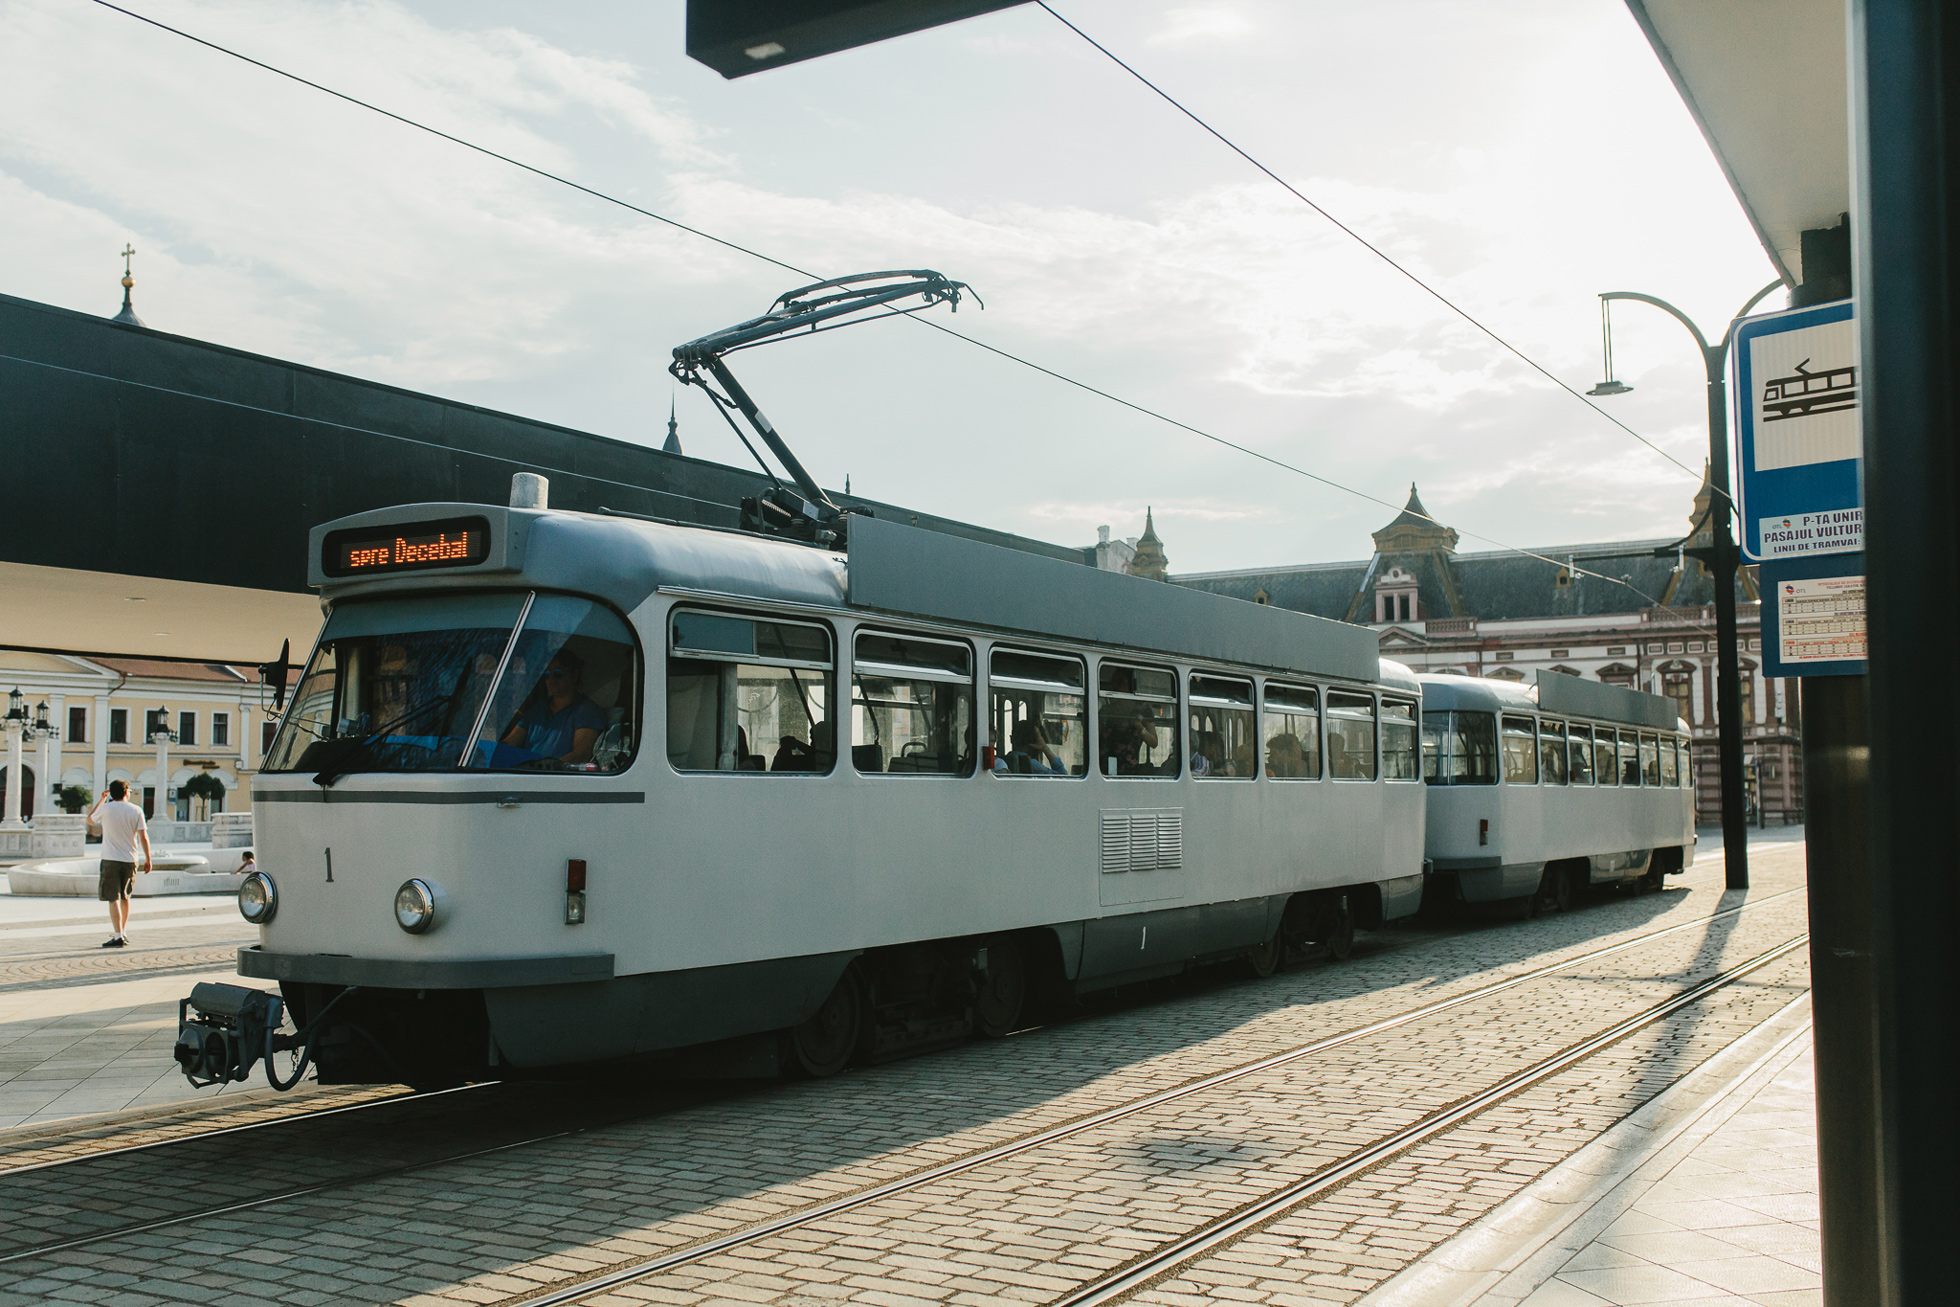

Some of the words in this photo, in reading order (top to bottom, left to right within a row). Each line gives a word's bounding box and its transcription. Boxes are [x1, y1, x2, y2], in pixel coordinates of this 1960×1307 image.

[1764, 527, 1814, 543] PASAJUL
[1773, 544, 1796, 553] LINII
[1798, 542, 1810, 551] DE
[1812, 538, 1861, 550] TRAMVAI:
[350, 548, 389, 567] spre
[395, 531, 468, 563] Decebal
[324, 847, 335, 883] 1
